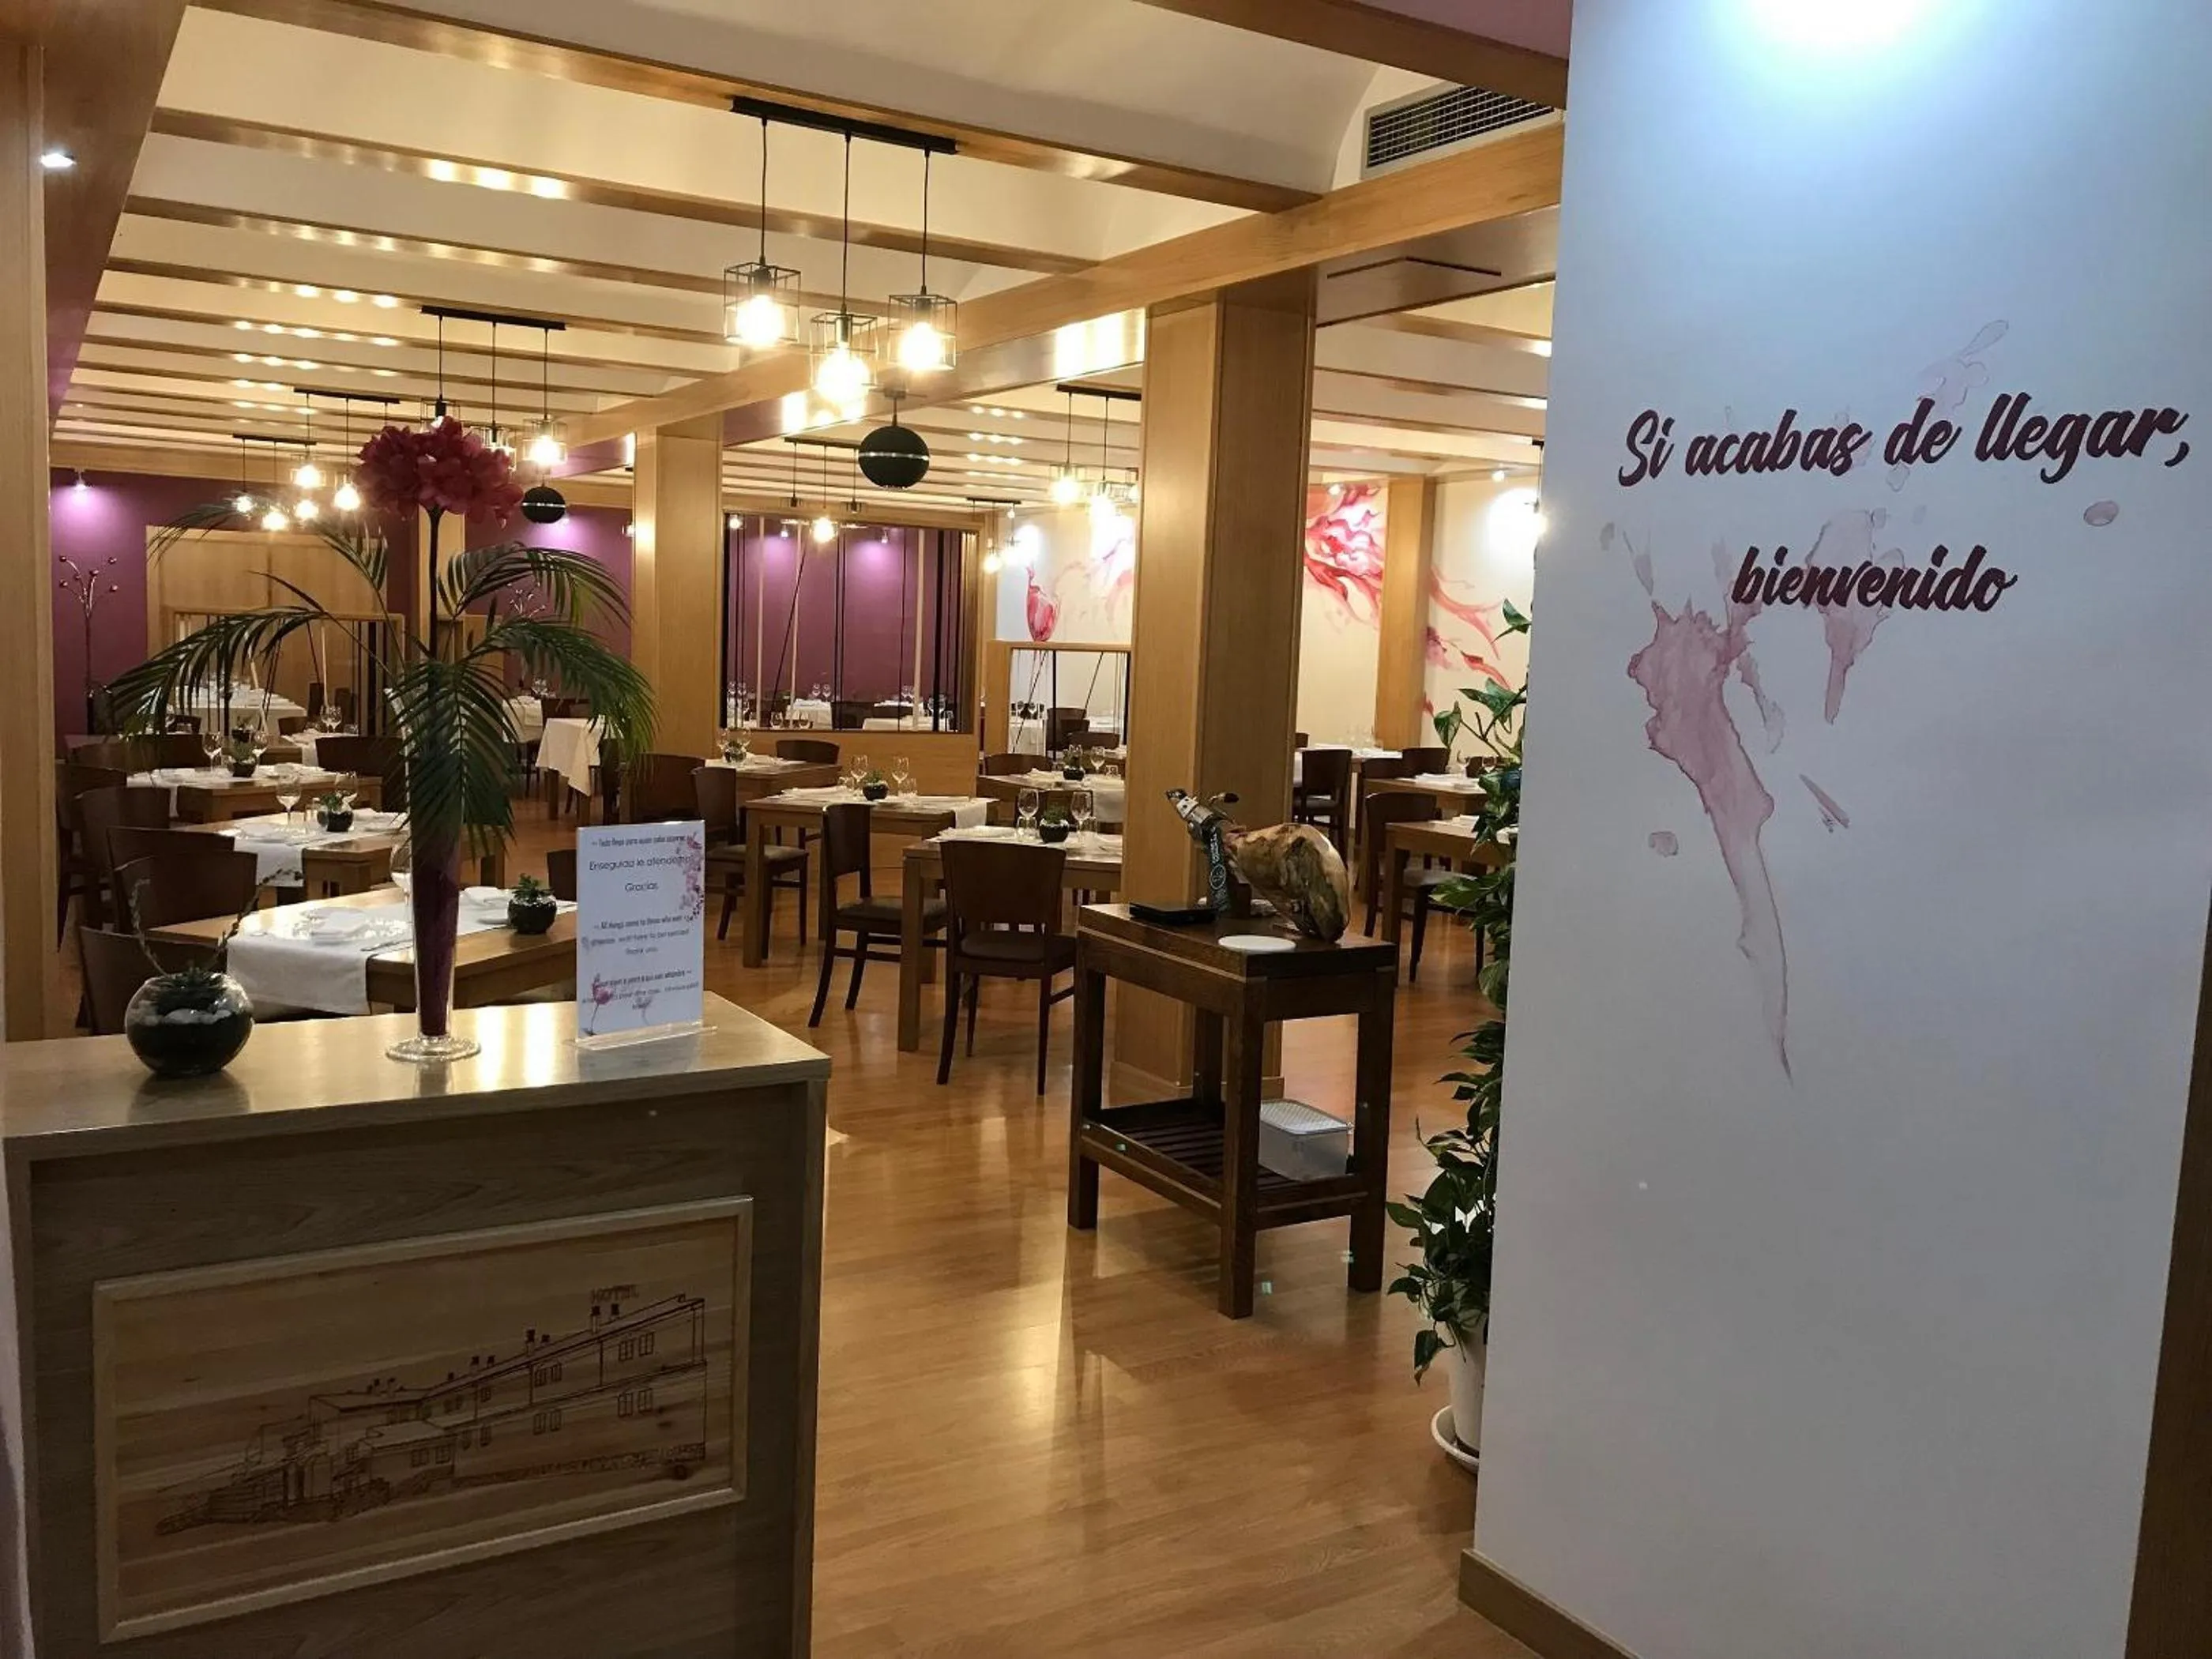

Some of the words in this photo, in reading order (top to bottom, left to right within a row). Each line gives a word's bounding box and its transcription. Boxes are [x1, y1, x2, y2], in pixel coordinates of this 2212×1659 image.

[1619, 410, 1674, 487] Si
[1685, 409, 1873, 476] acabas
[1883, 398, 1962, 465] de
[1974, 392, 2190, 484] llegar,
[1731, 544, 2018, 611] bienvenido
